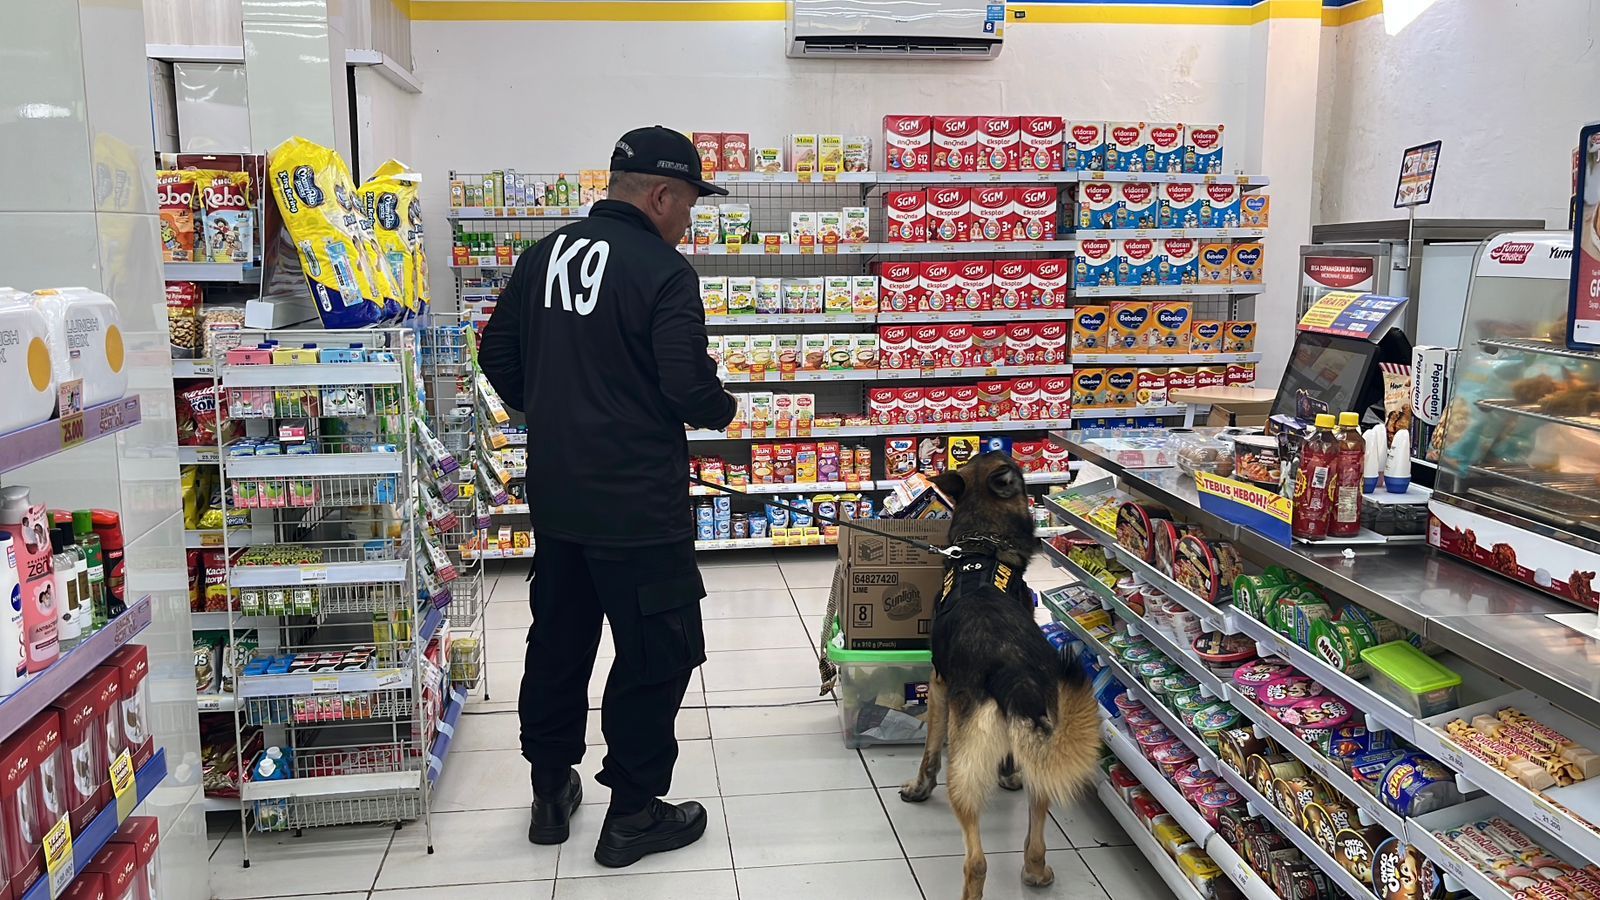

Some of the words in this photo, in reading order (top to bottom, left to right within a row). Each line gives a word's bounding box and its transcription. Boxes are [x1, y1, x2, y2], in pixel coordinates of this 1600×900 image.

[986, 23, 992, 31] 6
[899, 120, 919, 132] SGM
[945, 121, 966, 133] SGM
[988, 120, 1009, 132] SGM
[1031, 120, 1052, 132] SGM
[1074, 128, 1096, 136] vidoran
[1113, 129, 1137, 138] vidoran
[1152, 130, 1175, 139] vidoran
[1193, 132, 1216, 140] vidoran
[986, 138, 1011, 147] Eksplor
[1030, 138, 1054, 147] Eksplor
[1086, 187, 1110, 196] vidoran
[1123, 187, 1147, 196] vidoran
[1167, 186, 1192, 195] vidoran
[1209, 186, 1232, 195] vidoran
[204, 187, 246, 212] Rebo
[897, 195, 916, 207] SGM
[937, 192, 959, 204] SGM
[982, 192, 1003, 204] SGM
[1024, 192, 1046, 203] SGM
[936, 209, 960, 218] Eksplor
[980, 209, 1004, 218] Eksplor
[1023, 209, 1047, 218] Eksplor
[1083, 241, 1108, 250] vidoran
[1125, 242, 1150, 250] vidoran
[1166, 241, 1190, 249] vidoran
[890, 267, 910, 277] SGM
[928, 266, 947, 277] SGM
[964, 265, 984, 275] SGM
[1003, 264, 1022, 275] SGM
[1039, 264, 1059, 275] SGM
[544, 234, 610, 316] K9
[889, 282, 911, 290] Eksplor
[926, 282, 949, 290] Eksplor
[963, 280, 985, 288] Eksplor
[1001, 279, 1023, 288] Eksplor
[66, 317, 100, 334] LUNCH
[887, 329, 904, 339] SGM
[919, 328, 936, 338] SGM
[949, 327, 965, 338] SGM
[983, 329, 996, 337] SGM
[1013, 327, 1030, 337] SGM
[1043, 326, 1060, 336] SGM
[67, 333, 90, 349] BOX
[1017, 380, 1033, 390] SGM
[1412, 352, 1424, 412] Pepsodent
[988, 384, 1001, 392] SGM
[1430, 363, 1443, 418] Pepsodent
[877, 391, 892, 400] SGM
[904, 391, 919, 400] SGM
[931, 390, 946, 399] SGM
[958, 389, 972, 398] SGM
[1203, 478, 1231, 496] TEBUS
[1233, 487, 1268, 510] HEBOH!
[963, 563, 982, 571] K-9
[854, 574, 897, 584] 64827420
[884, 589, 921, 612] Sunlight
[859, 606, 867, 620] 8
[1319, 639, 1340, 667] MILO
[1344, 839, 1364, 847] CHOCO
[1344, 845, 1368, 861] CHIPS
[1380, 853, 1388, 884] CHOCO
[1387, 852, 1400, 893] CHIPS
